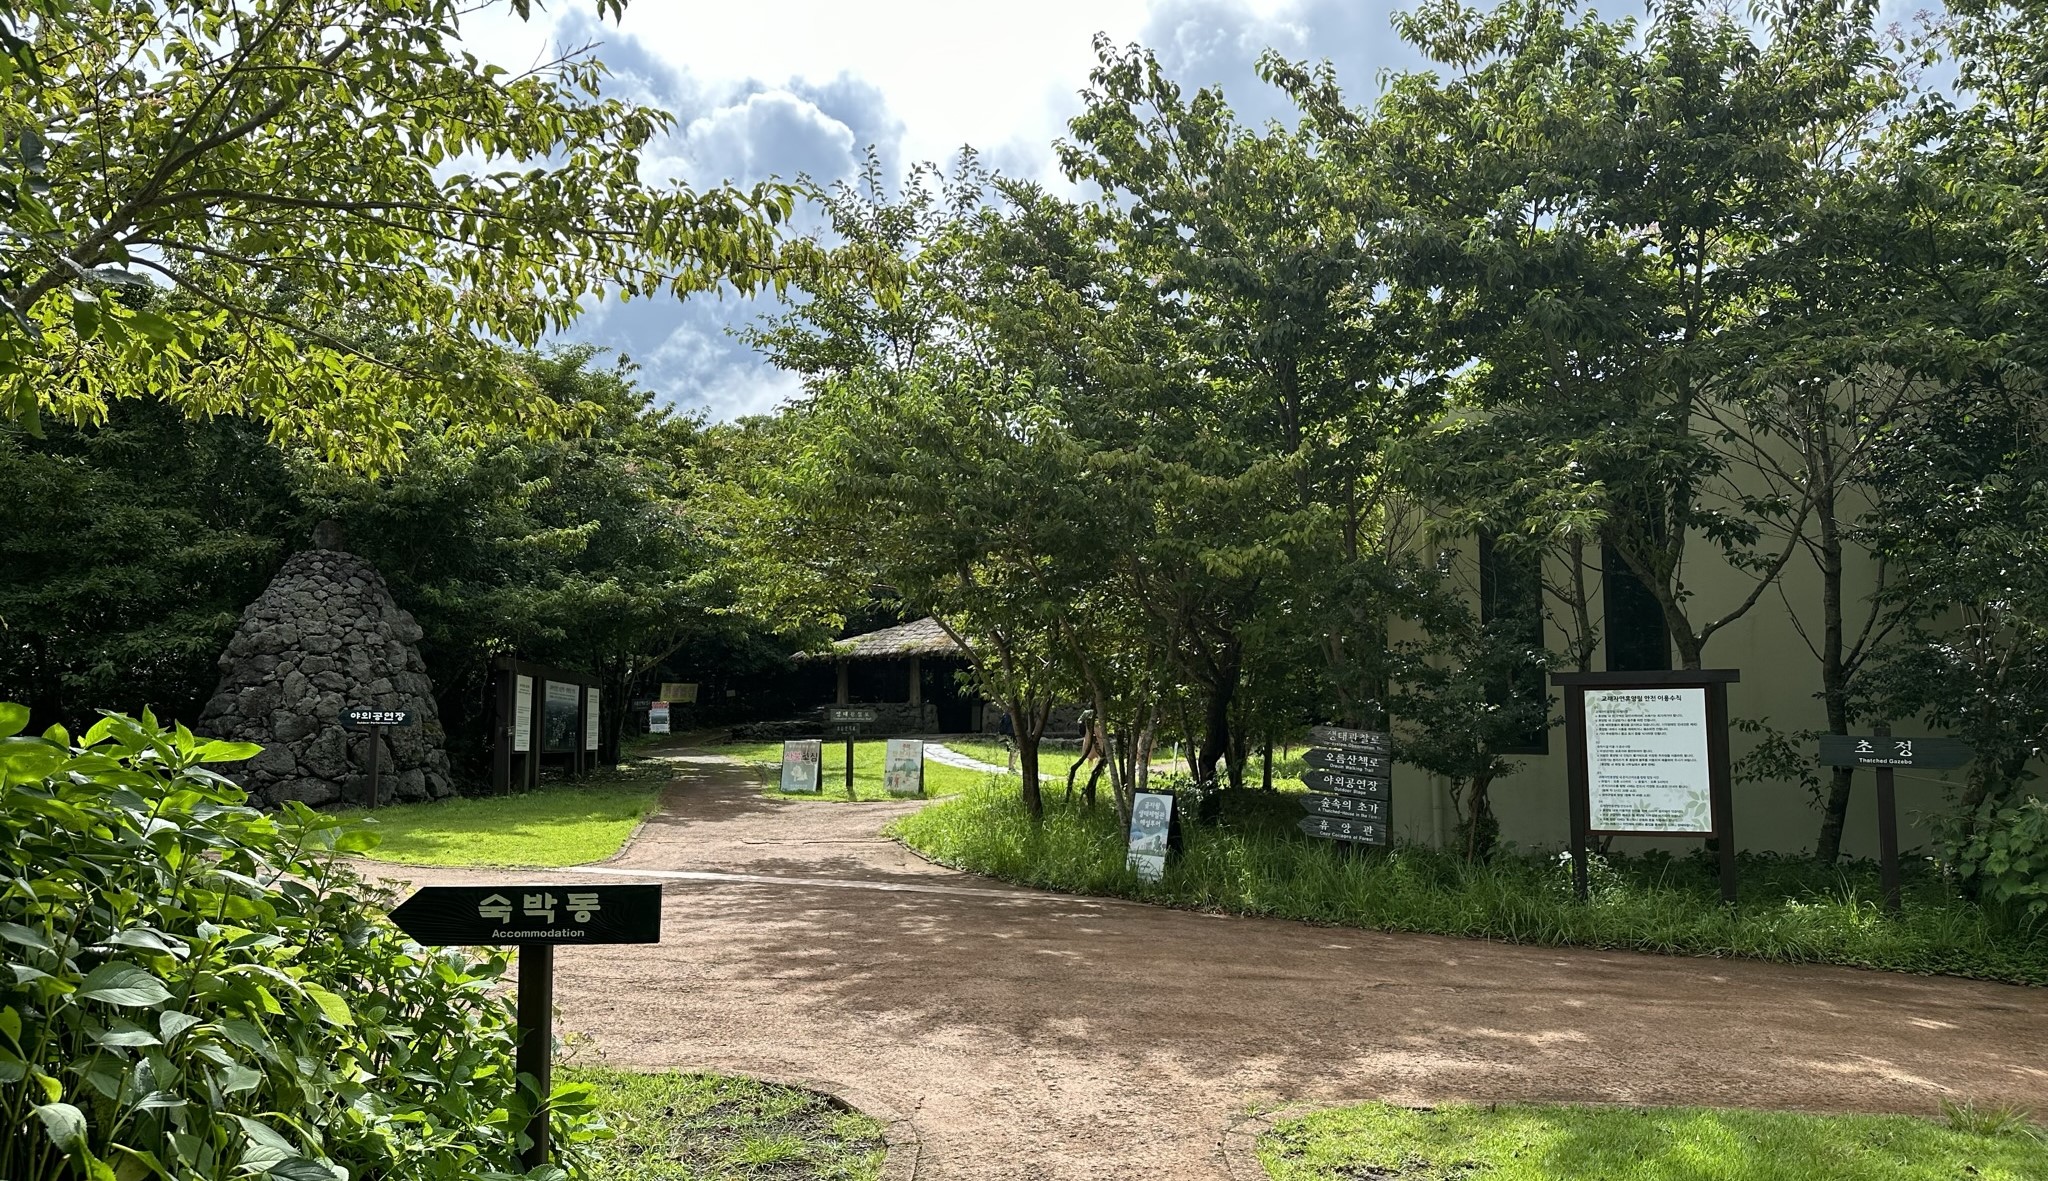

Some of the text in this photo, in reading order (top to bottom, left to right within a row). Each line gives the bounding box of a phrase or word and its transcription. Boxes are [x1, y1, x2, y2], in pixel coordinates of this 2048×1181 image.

[1657, 694, 1682, 702] 이용수칙
[350, 712, 405, 722] 야외공연장
[1327, 730, 1380, 745] 생태관찰로
[1324, 752, 1380, 767] 오름산책로
[1323, 775, 1378, 791] 야외공연장
[1320, 797, 1379, 814] 숲속의 초가
[477, 892, 601, 924] 숙박동
[491, 928, 585, 938] Accommodation
